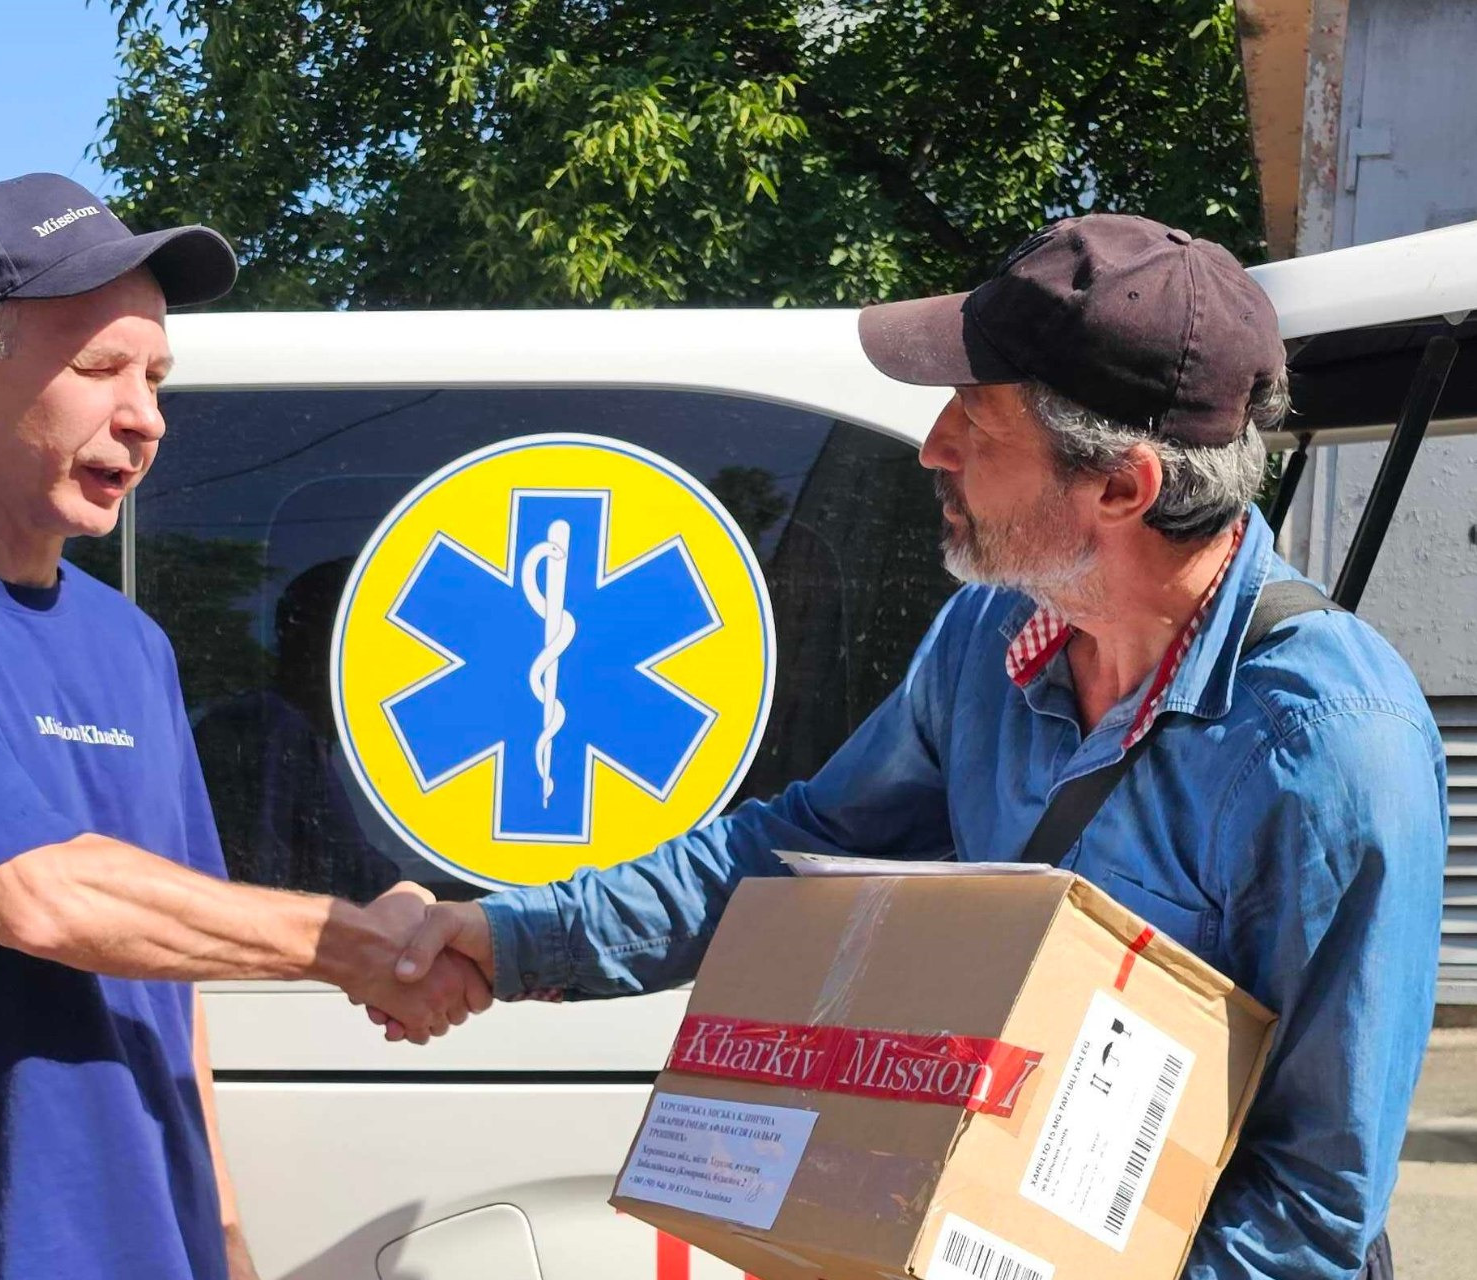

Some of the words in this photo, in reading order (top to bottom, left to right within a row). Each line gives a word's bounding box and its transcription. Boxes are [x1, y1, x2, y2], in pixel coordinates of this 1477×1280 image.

[31, 205, 101, 237] Mission
[683, 1022, 824, 1080] Kharkiv
[838, 1037, 995, 1104] Mission
